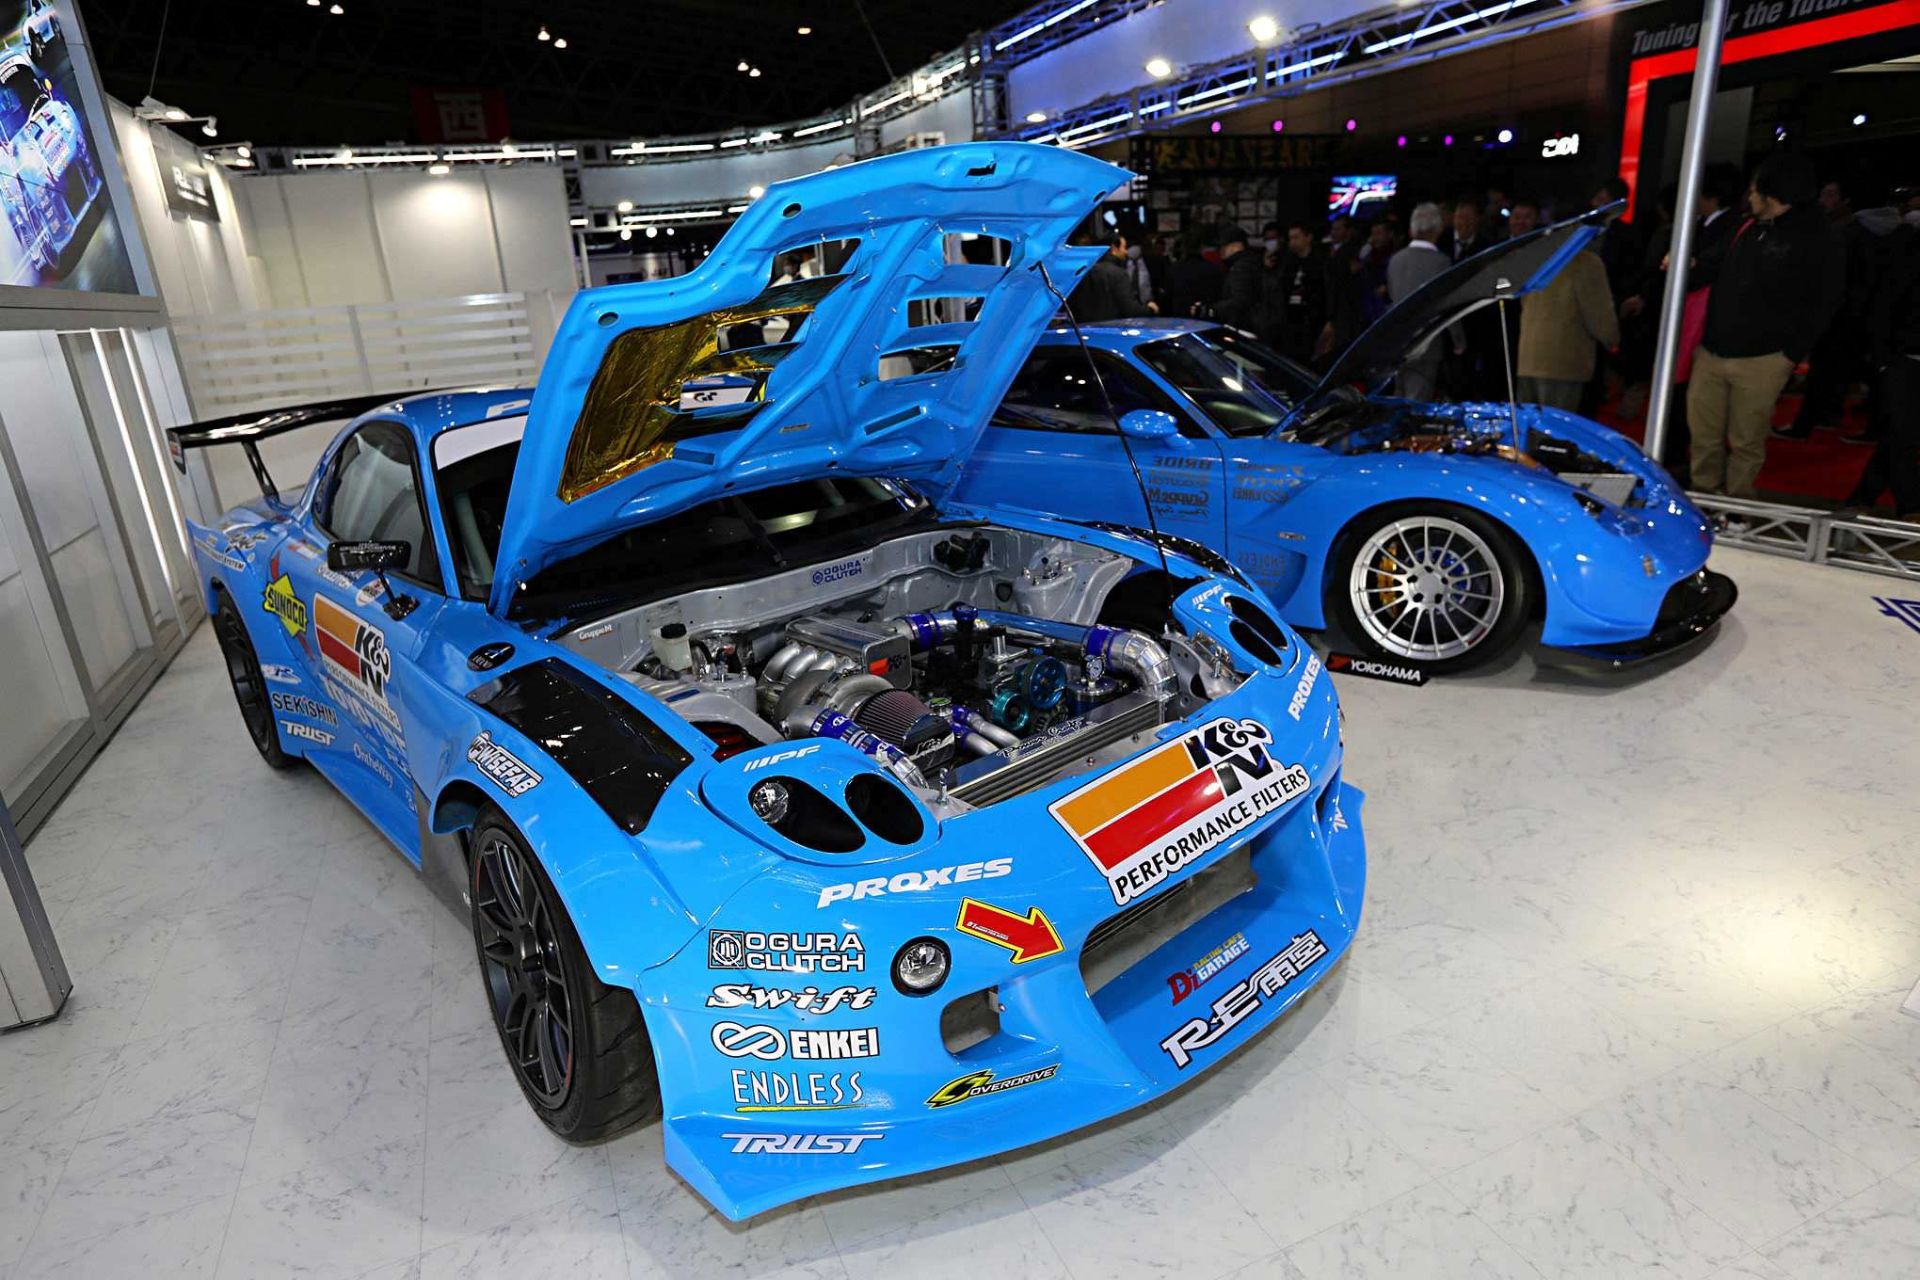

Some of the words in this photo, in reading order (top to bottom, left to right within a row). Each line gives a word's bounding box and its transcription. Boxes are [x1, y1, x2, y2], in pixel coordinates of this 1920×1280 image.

[1632, 22, 1699, 55] Tuning
[1743, 2, 1781, 30] the
[824, 559, 862, 576] OGURA
[267, 585, 306, 628] SUNOCO
[1288, 654, 1321, 721] PROXES
[1351, 660, 1422, 683] YOKOHAMA
[280, 720, 336, 746] TRUST
[477, 745, 539, 794] WISEFAB
[1184, 717, 1272, 797] K&N
[1115, 807, 1252, 899] PERFORMANCE
[1252, 770, 1310, 812] FILTERS
[816, 857, 1014, 910] PROXES
[745, 932, 865, 952] OGURA
[1196, 937, 1250, 981] GARAGE
[745, 950, 865, 973] CLUTCH
[705, 982, 878, 1015] Swift
[790, 1027, 880, 1060] ENKEI
[731, 1068, 865, 1106] ENDLESS
[969, 1067, 1055, 1096] OVERDRIVE
[720, 1131, 885, 1155] TRUST
